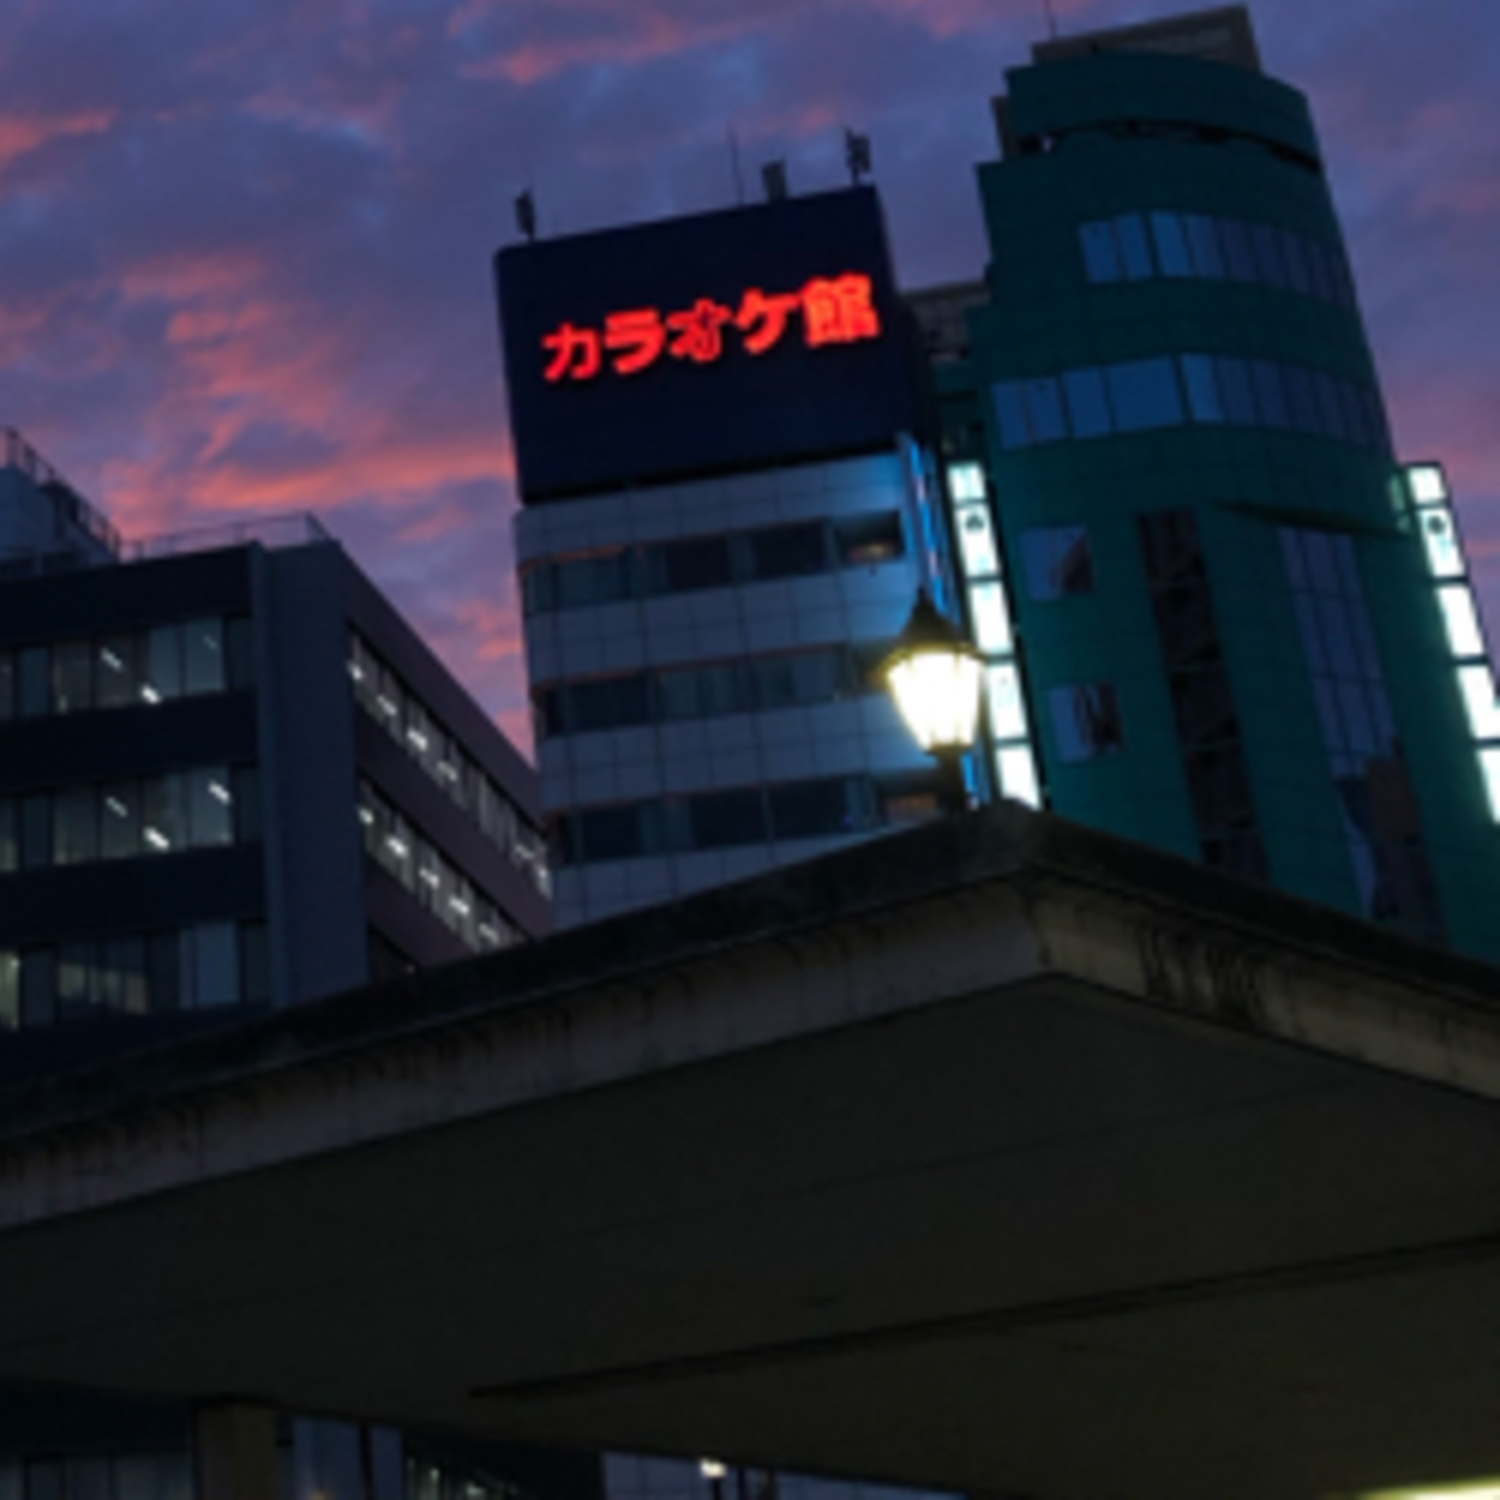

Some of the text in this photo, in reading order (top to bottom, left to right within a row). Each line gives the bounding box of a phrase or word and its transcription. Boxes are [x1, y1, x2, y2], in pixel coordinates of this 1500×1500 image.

[541, 270, 882, 383] カラオケ館
